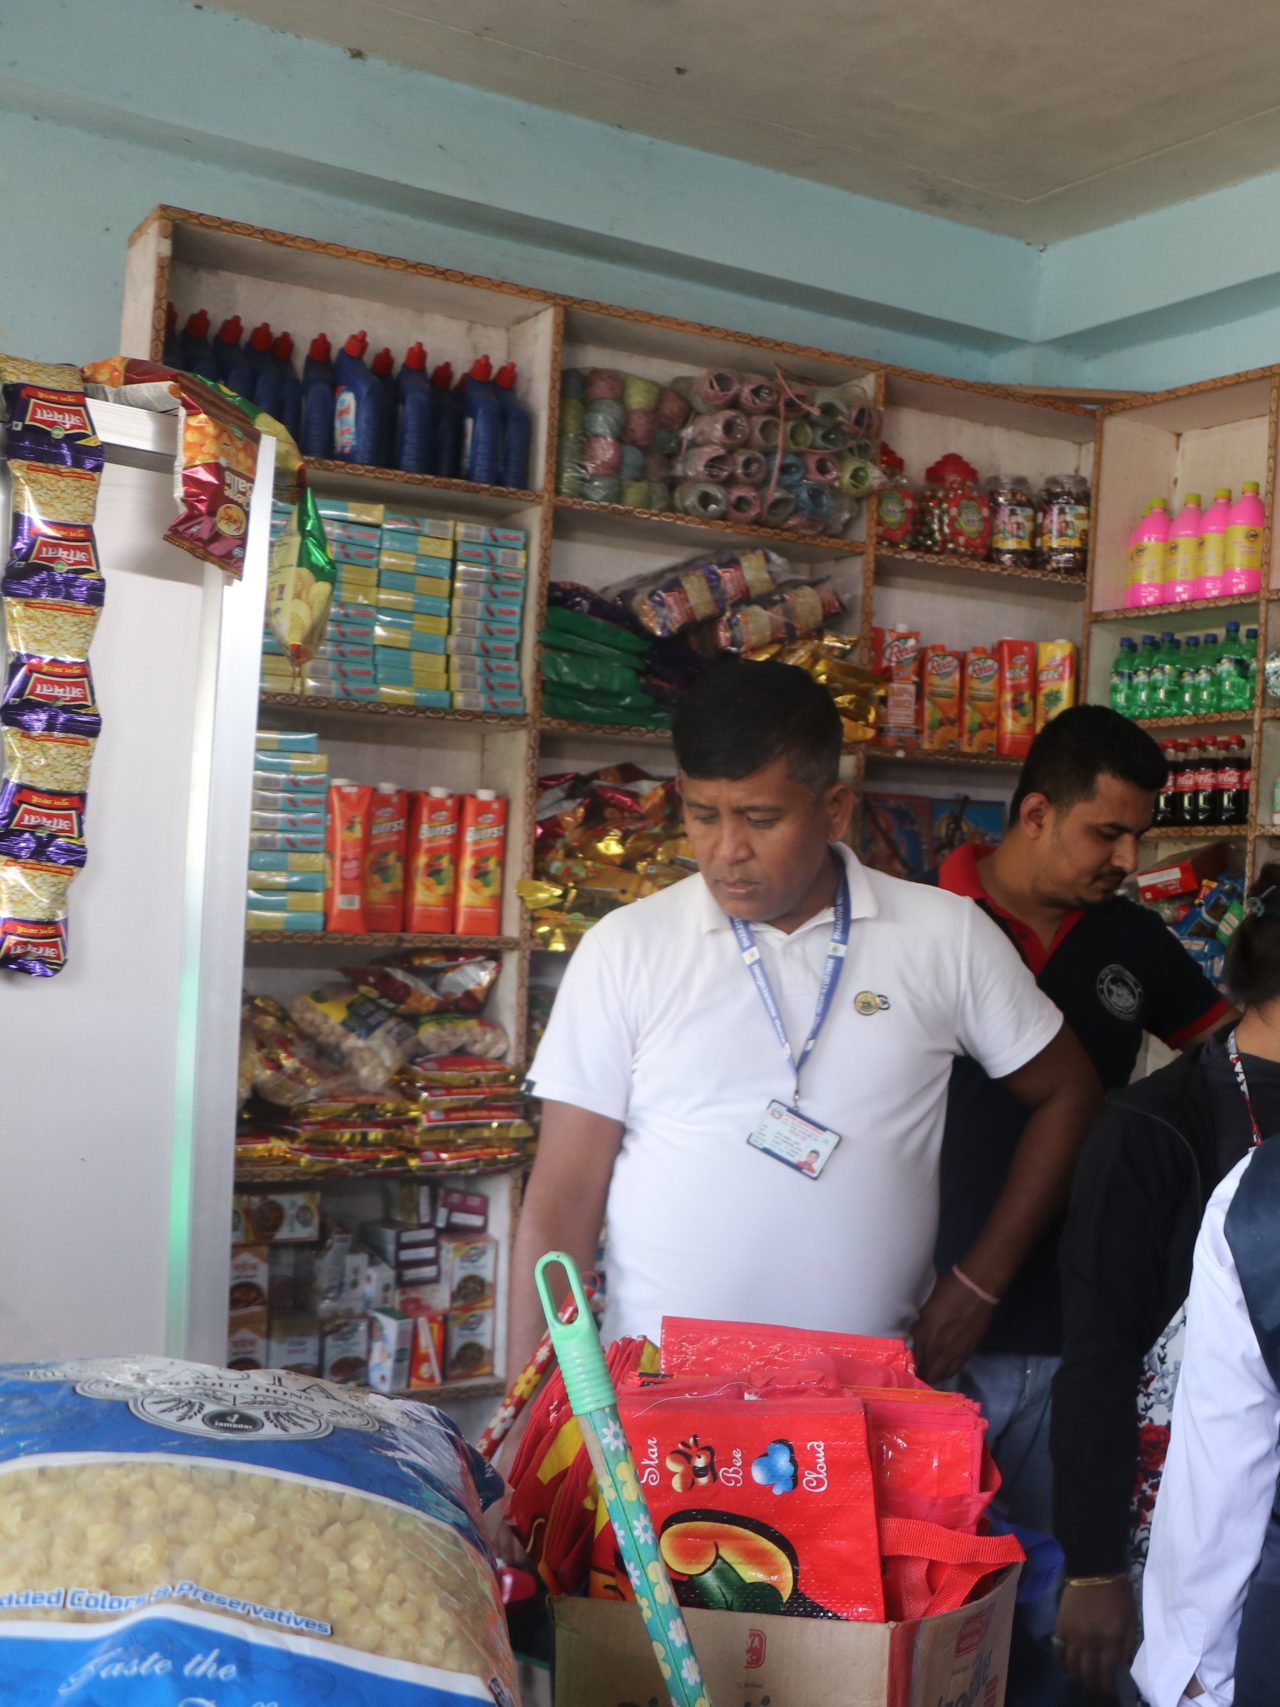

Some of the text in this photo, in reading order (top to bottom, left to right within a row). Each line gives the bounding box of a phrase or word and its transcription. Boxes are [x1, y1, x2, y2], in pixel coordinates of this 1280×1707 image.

[40, 545, 88, 563] अमिता
[36, 682, 86, 701] अमिता
[23, 813, 71, 831] अमिता
[640, 1437, 660, 1486] Star
[719, 1448, 743, 1487] Bee
[803, 1440, 828, 1493] Cloud
[174, 1581, 334, 1636] Preservatives
[58, 1647, 238, 1696] Taste the
